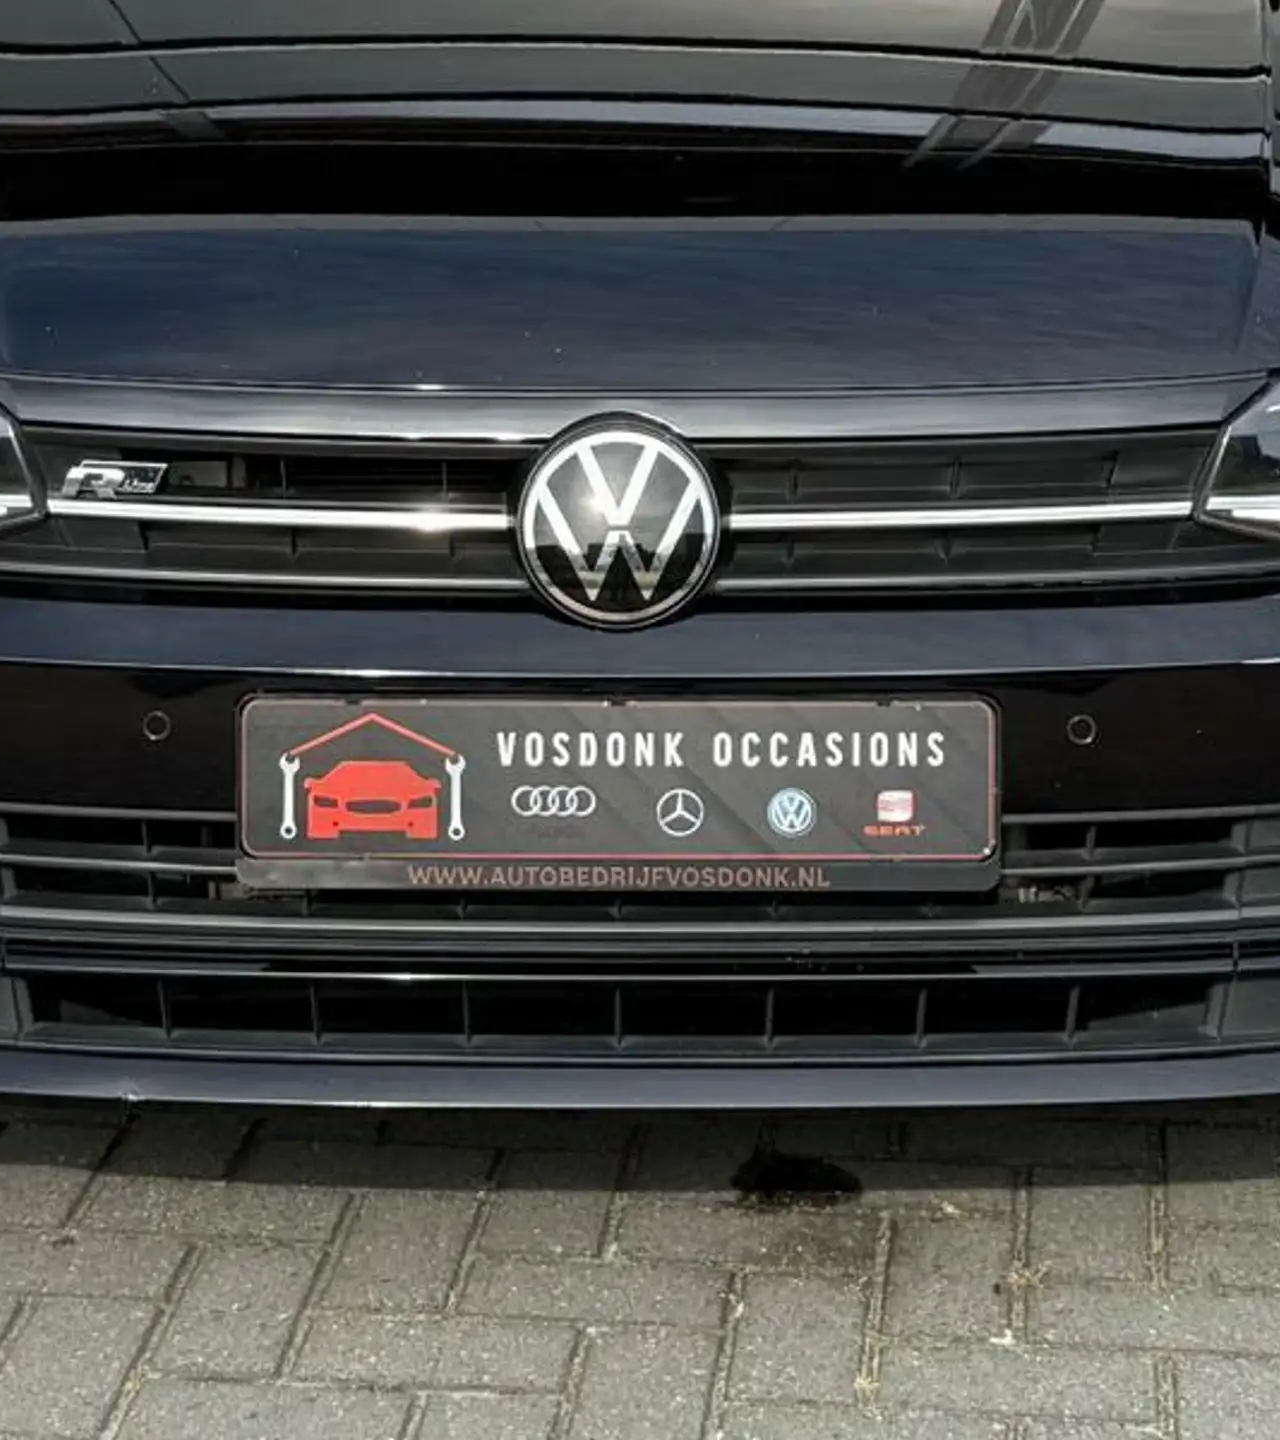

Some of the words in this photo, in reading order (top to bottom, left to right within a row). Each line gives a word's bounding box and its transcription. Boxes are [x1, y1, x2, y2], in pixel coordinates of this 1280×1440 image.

[497, 731, 685, 768] VOSDONK
[712, 731, 946, 768] OCCASIONS
[407, 865, 832, 889] WWW.AUTOBEDRIJFVOSDONK.NL
